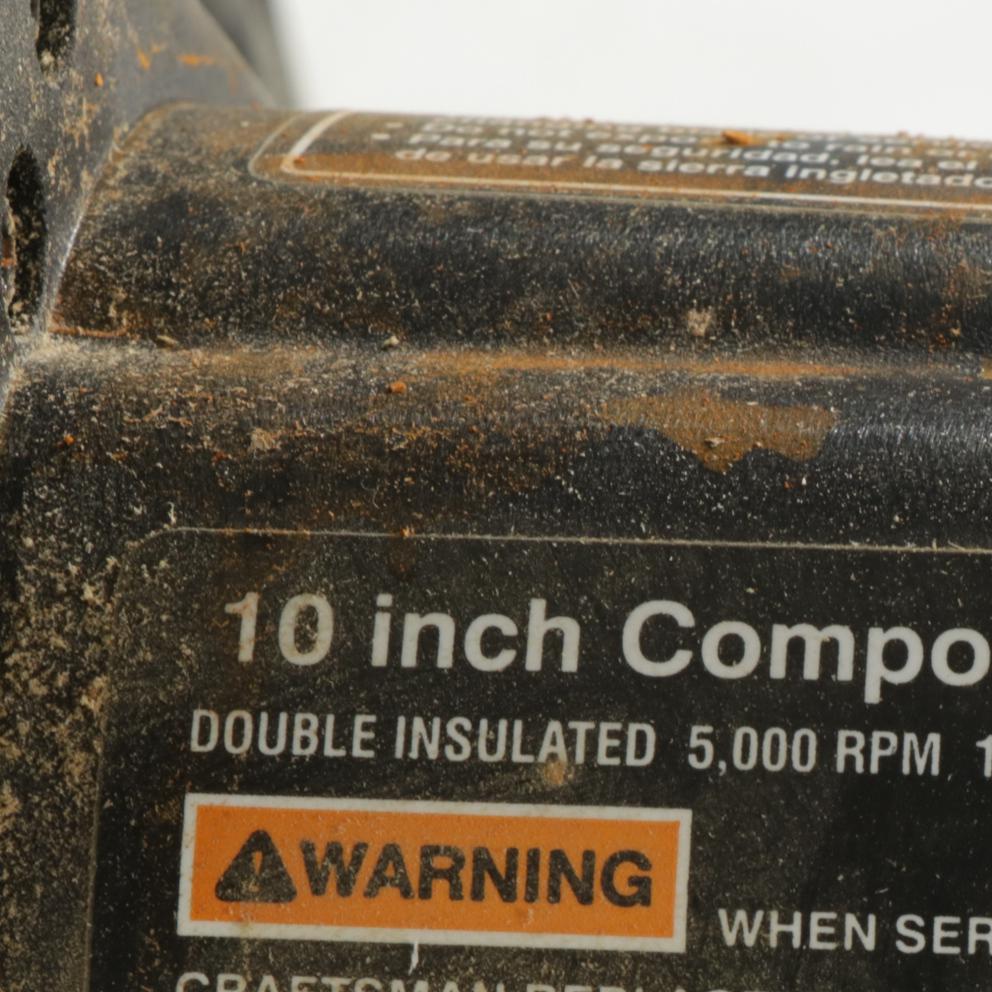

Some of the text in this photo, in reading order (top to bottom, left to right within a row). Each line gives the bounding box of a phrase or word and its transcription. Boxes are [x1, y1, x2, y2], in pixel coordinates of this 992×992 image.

[636, 159, 770, 178] sierra
[225, 592, 333, 666] 10
[371, 593, 582, 673] inch
[189, 709, 377, 761] DOUBLE
[395, 716, 656, 767] INSULATED
[687, 725, 818, 777] 5,000
[835, 729, 942, 776] RPM
[301, 840, 654, 908] WARNING
[717, 908, 878, 952] WHEN
